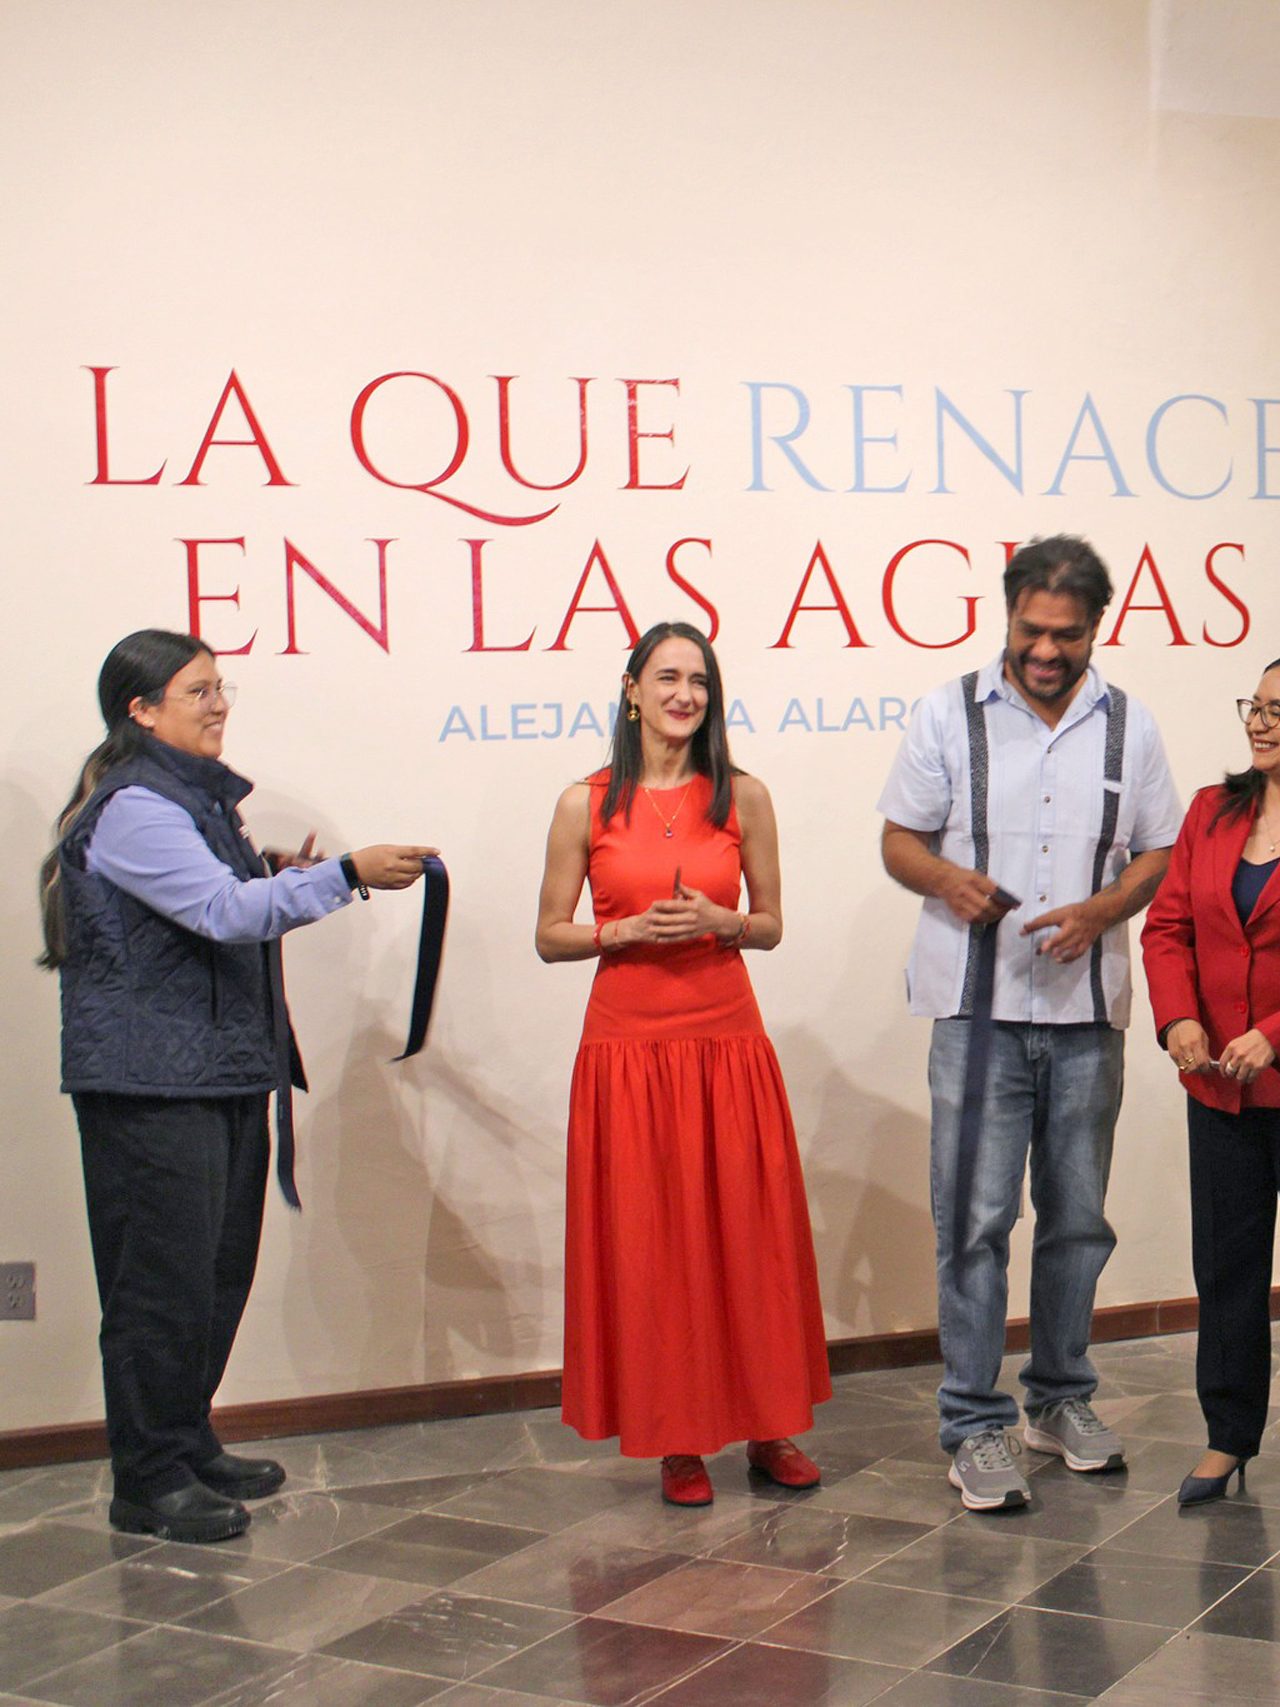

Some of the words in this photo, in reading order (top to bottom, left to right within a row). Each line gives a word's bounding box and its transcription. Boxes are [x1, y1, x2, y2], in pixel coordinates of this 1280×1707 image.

[82, 365, 300, 488] LA
[349, 370, 691, 527] QUE
[174, 535, 399, 657] EN
[458, 537, 721, 654] LAS
[766, 538, 1252, 650] AGAS
[438, 698, 757, 743] ALEJAA
